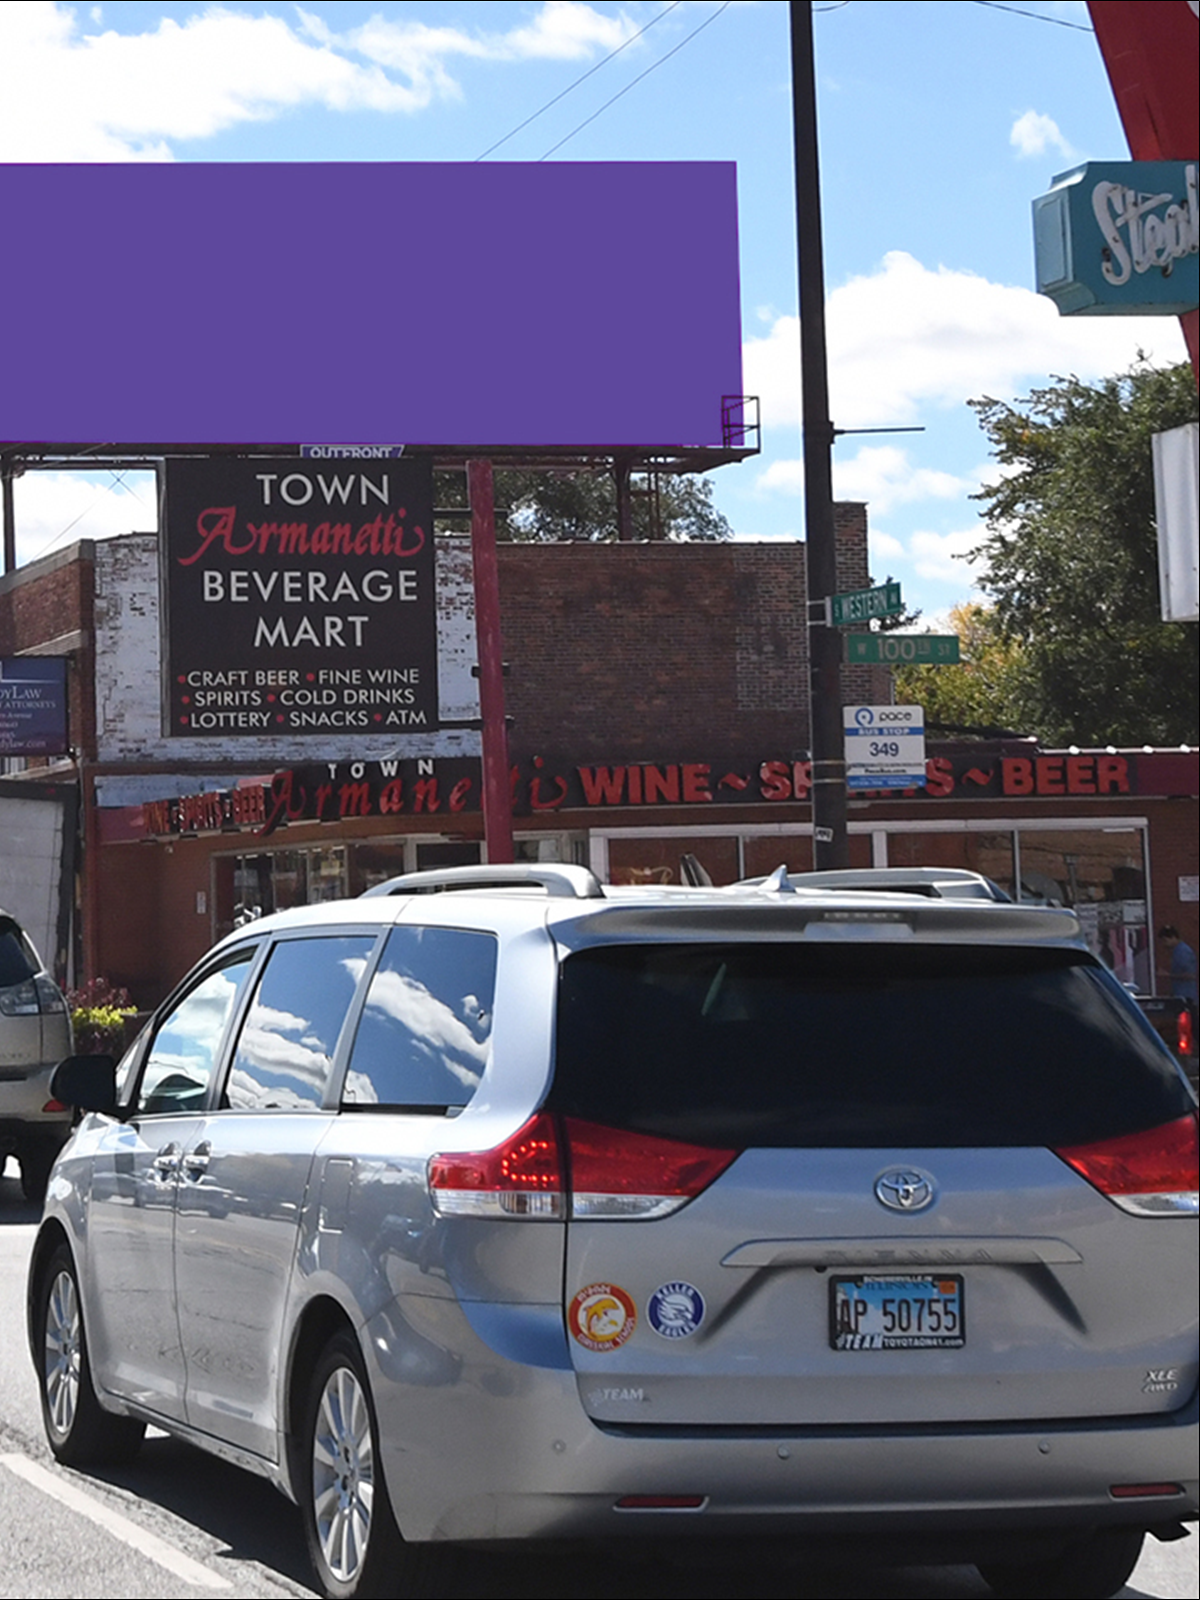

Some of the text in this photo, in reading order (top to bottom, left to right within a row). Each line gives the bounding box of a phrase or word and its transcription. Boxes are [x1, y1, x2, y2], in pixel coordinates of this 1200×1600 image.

[310, 446, 392, 459] OUTFRONT
[256, 473, 390, 506] TOWN
[177, 505, 425, 566] Armanetti
[203, 569, 418, 603] BEVERAGE
[841, 589, 888, 618] WESTERN
[253, 615, 369, 648] MART
[187, 668, 420, 687] CRAFT BEER FINE WINE
[194, 688, 415, 707] SPIRITS COLD DRINKS
[190, 709, 427, 728] LOTTERY SNACKS ATM
[880, 711, 912, 721] pace
[870, 741, 899, 757] 349
[328, 759, 433, 780] TOWN
[1001, 756, 1131, 796] BEER
[577, 762, 713, 806] WINE
[655, 1283, 695, 1300] KELLER
[840, 1298, 957, 1334] AP 50755
[658, 1321, 697, 1337] EAGLES
[1145, 1368, 1178, 1381] XLE
[602, 1388, 644, 1401] TEAM
[1142, 1381, 1178, 1393] AWD
